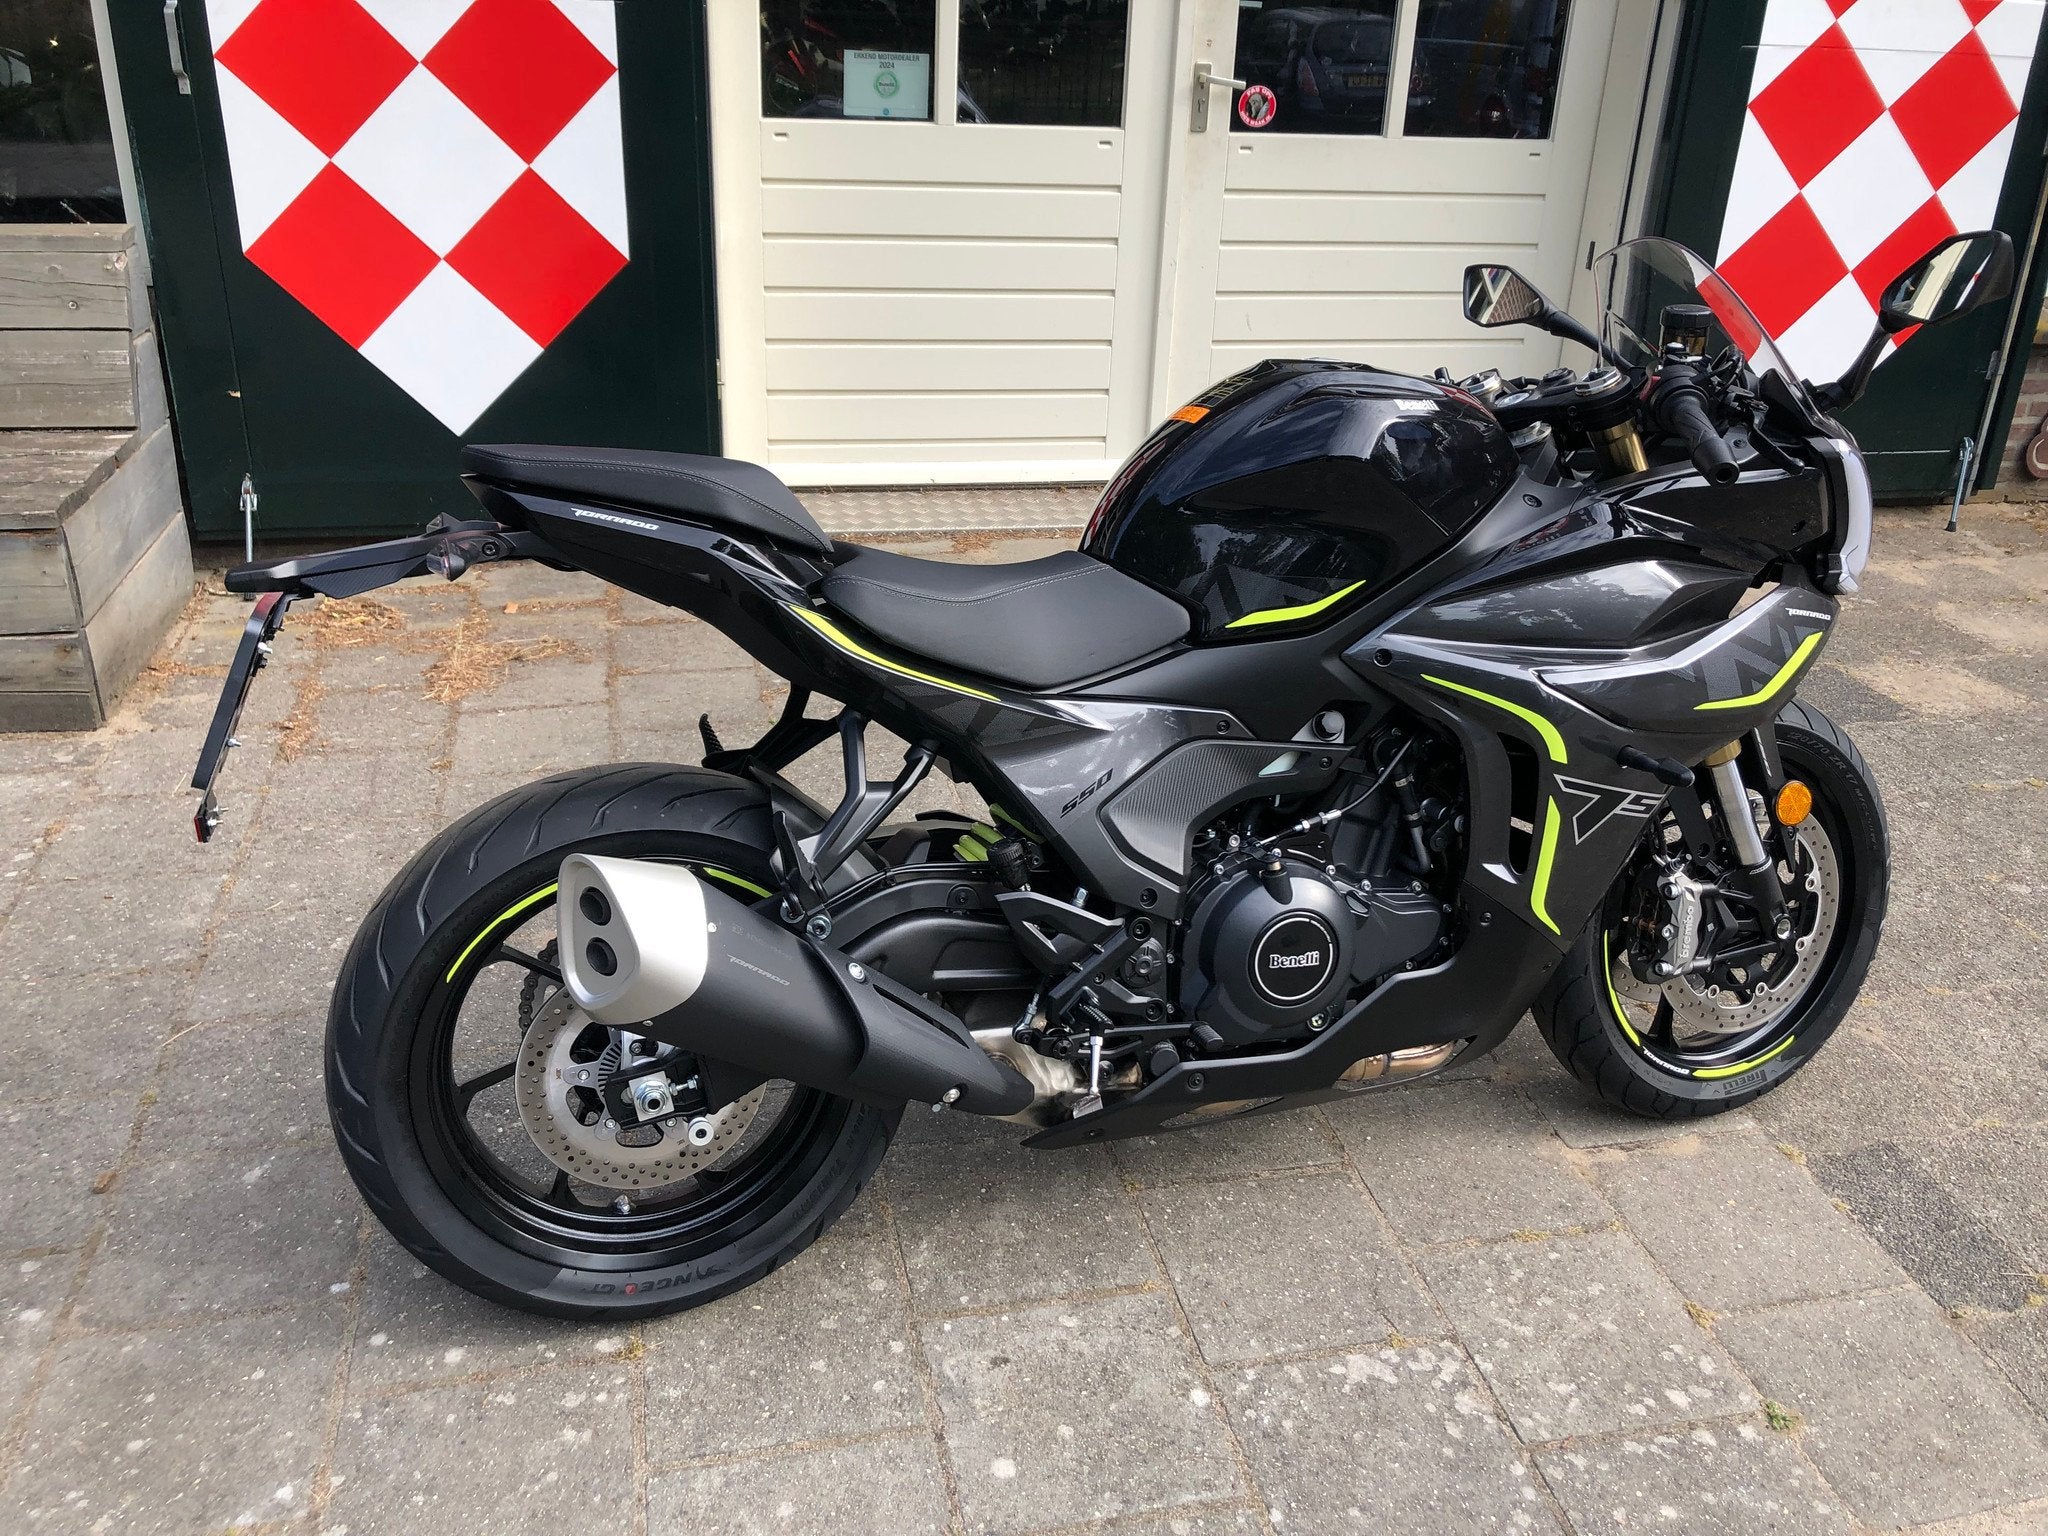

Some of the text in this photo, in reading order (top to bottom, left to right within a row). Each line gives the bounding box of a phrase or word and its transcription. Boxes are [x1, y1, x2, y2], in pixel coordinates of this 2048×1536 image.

[878, 53, 920, 61] MOTORDEALER
[879, 61, 895, 69] 2024
[571, 508, 659, 531] TORNADO
[1785, 607, 1831, 621] TORNADO
[1060, 768, 1113, 819] 550
[1680, 905, 1694, 958] brembo
[727, 954, 790, 985] TORNADO
[1269, 950, 1320, 969] Benelli
[1642, 1046, 1690, 1075] TORNADO
[1723, 1069, 1767, 1096] PIRELLI
